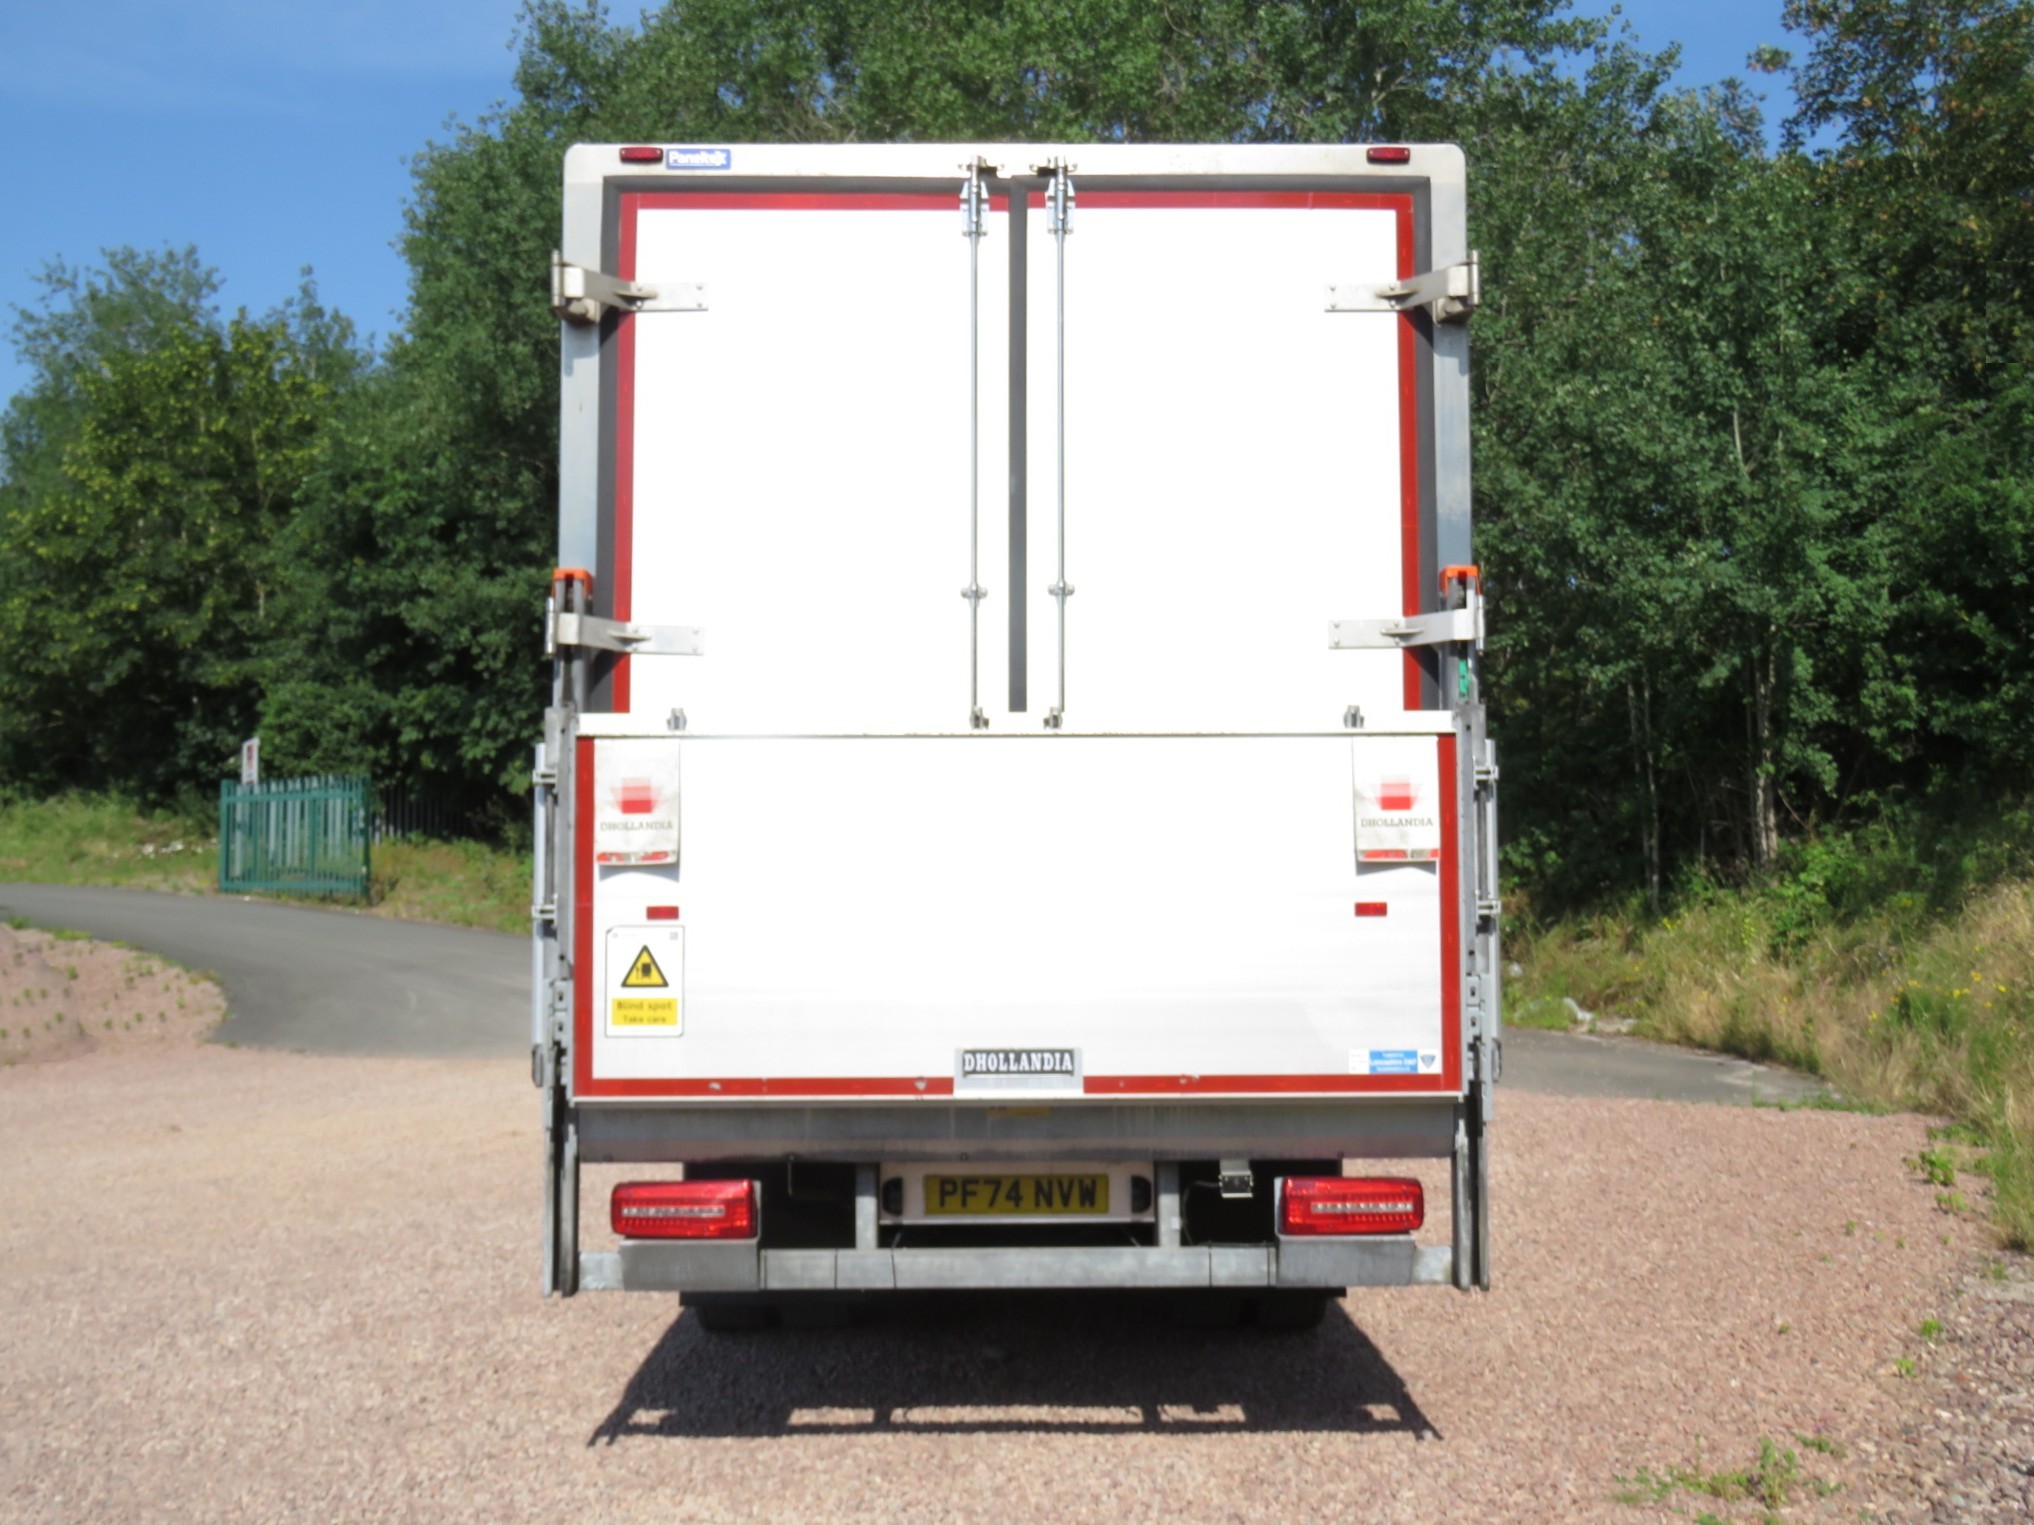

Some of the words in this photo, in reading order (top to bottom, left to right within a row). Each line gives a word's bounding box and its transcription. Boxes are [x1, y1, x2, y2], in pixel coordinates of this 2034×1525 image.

[600, 821, 673, 831] DHOLLANDIA
[1360, 818, 1433, 828] DHOLLANDIA
[617, 1001, 644, 1011] Blind
[648, 1002, 672, 1012] spot
[963, 1051, 1073, 1072] DHOLLANDIA
[939, 1178, 1023, 1208] PF74
[1034, 1177, 1097, 1208] NVW
